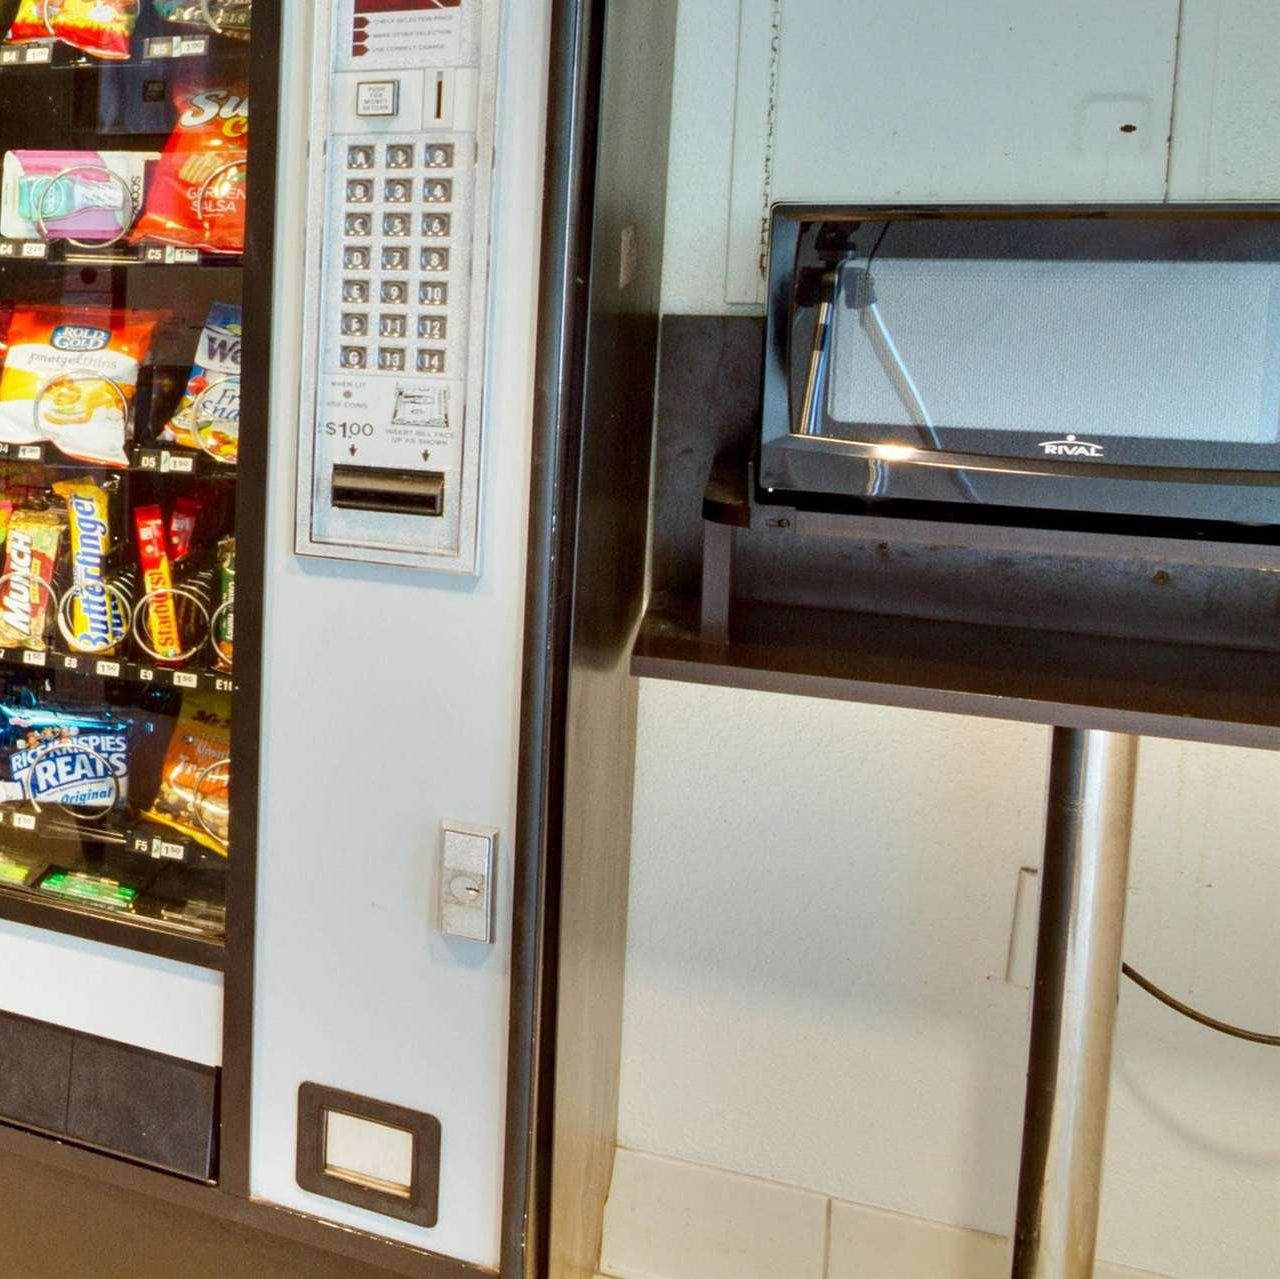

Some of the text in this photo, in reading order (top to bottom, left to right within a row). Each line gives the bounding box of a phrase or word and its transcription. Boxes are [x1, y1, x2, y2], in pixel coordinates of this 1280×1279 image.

[394, 184, 405, 198] 3
[354, 218, 441, 232] C 5 6
[0, 244, 14, 255] C4
[147, 249, 162, 260] C5
[353, 252, 440, 266] D 7 8
[351, 284, 441, 300] E 9 10
[351, 318, 441, 334] F 11 12
[61, 326, 106, 341] ROLD
[55, 335, 106, 351] GOLD
[207, 335, 241, 366] We
[385, 352, 400, 366] 13
[424, 354, 439, 368] 14
[1044, 444, 1103, 457] RIVAL
[141, 455, 156, 467] D5
[1, 530, 33, 636] MUNCH
[64, 657, 78, 669] E8
[140, 668, 153, 681] E9
[14, 753, 128, 792] TREATS
[59, 786, 114, 805] Original
[135, 840, 148, 852] F5
